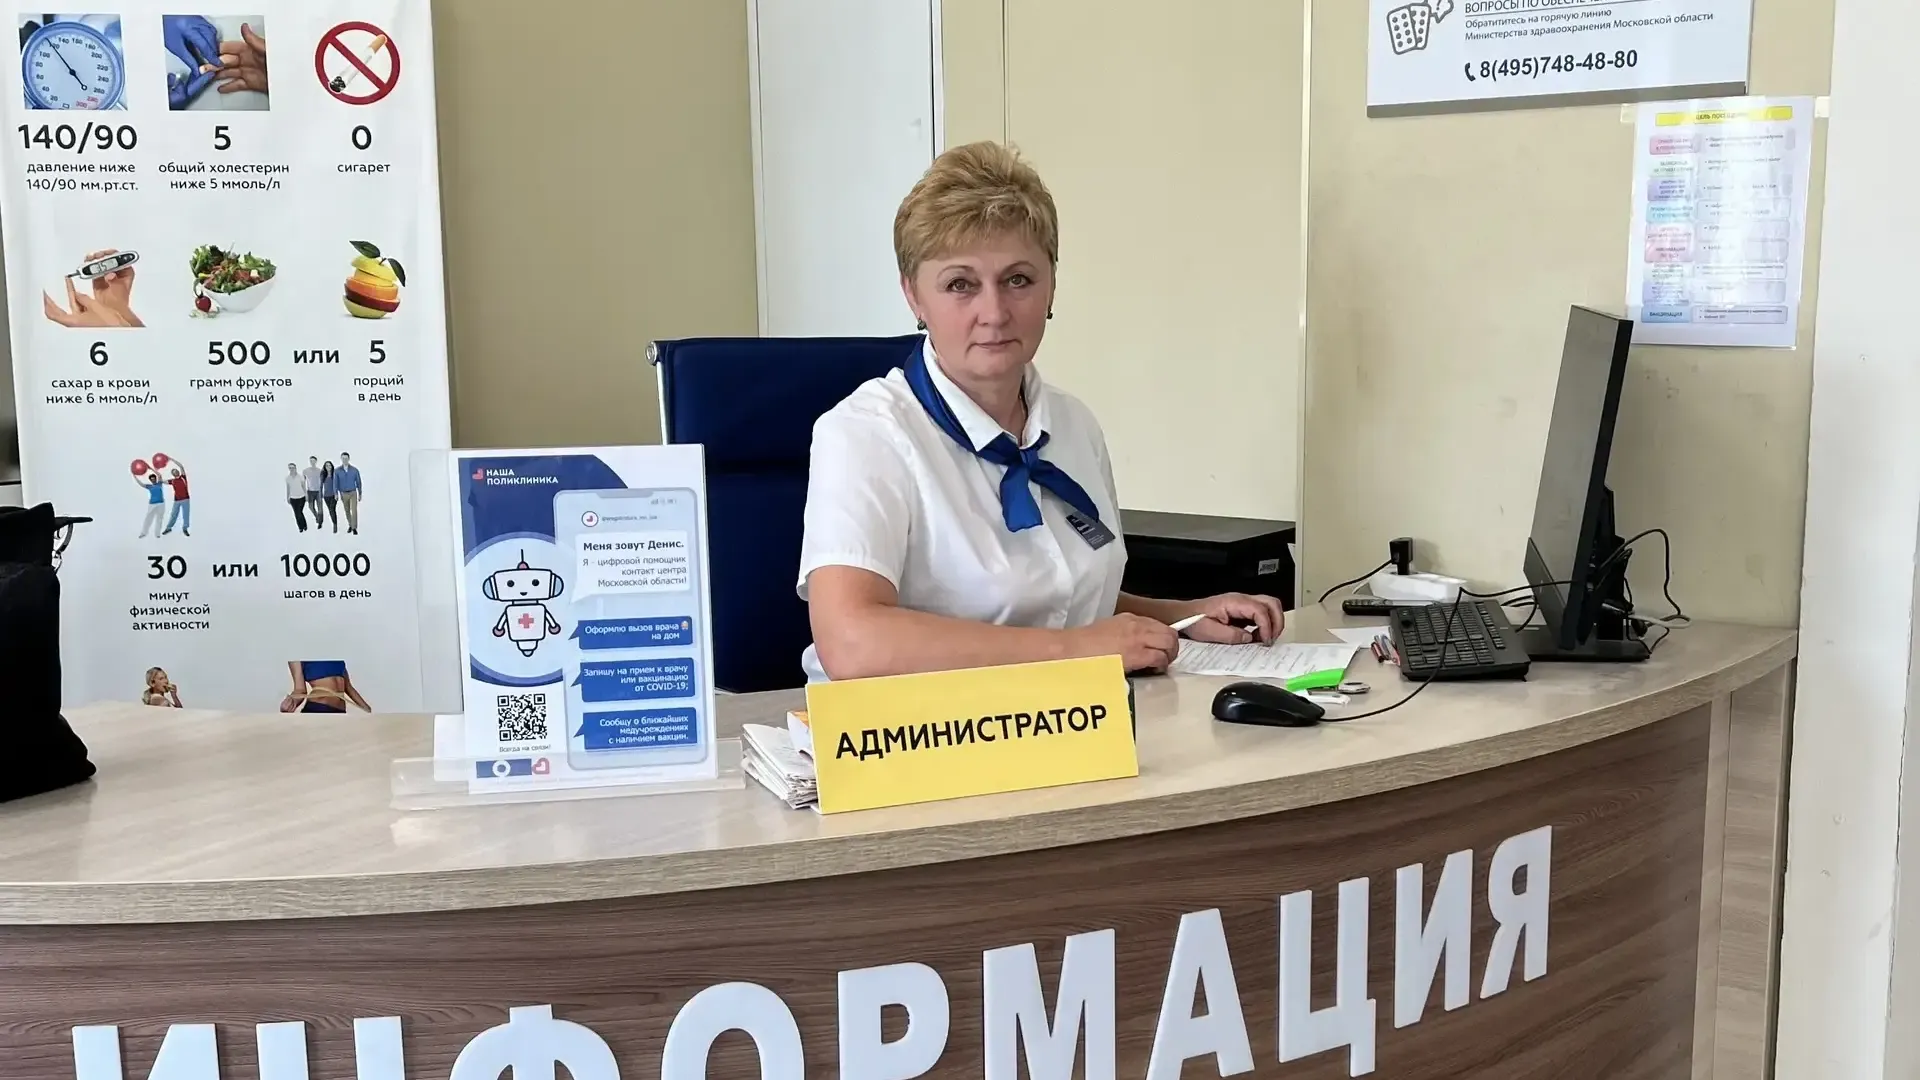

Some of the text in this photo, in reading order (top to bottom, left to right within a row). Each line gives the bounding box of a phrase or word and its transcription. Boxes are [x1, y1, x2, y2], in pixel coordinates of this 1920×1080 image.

[1465, 0, 1519, 13] ВОПРОСЫ
[1466, 17, 1526, 29] Обратититесь
[1541, 11, 1579, 23] горячую
[1581, 9, 1612, 18] линию
[1465, 12, 1714, 41] Министерства здравоохранения Московской области
[1480, 50, 1638, 81] 8(495)748-48-80
[18, 122, 137, 154] 140/90
[215, 126, 231, 150] 5
[352, 125, 371, 150] 0
[27, 164, 95, 173] давление
[159, 162, 289, 175] общий холестерин
[338, 164, 390, 175] сигарет
[27, 178, 138, 192] 140/90 мм.рт.ст.
[171, 177, 280, 190] ниже 5 ммоль/л
[90, 342, 108, 366] 6
[209, 340, 385, 365] 500 или 5
[52, 380, 92, 390] сахар
[109, 380, 149, 390] крови
[190, 377, 292, 390] грамм фруктов
[354, 375, 403, 387] порций
[87, 393, 94, 403] 6
[99, 392, 157, 405] ммоль/л
[222, 392, 274, 404] овощей
[369, 393, 401, 402] день
[487, 476, 559, 485] ПОЛИКЛИНИКА
[583, 542, 612, 550] Меня
[648, 540, 684, 550] Денис.
[148, 553, 370, 579] 30 или 10000
[598, 557, 640, 568] цифровой
[643, 556, 686, 564] помощник
[622, 567, 686, 575] контакт центра
[598, 577, 686, 587] Московской области!
[150, 593, 189, 602] минут
[340, 590, 371, 599] день
[130, 604, 210, 617] физической
[133, 622, 209, 630] активности
[585, 626, 626, 635] Оформлю
[630, 667, 654, 675] прием
[639, 674, 688, 682] вакцинацию
[646, 682, 688, 691] COVID-19;
[600, 718, 631, 726] Сообщу
[641, 715, 688, 724] ближайших
[620, 725, 688, 734] медучреждениях
[836, 704, 1107, 760] АДМИНИСТРАТОР
[616, 735, 655, 743] наличием
[72, 825, 1552, 1080] РМАЦИЯ
